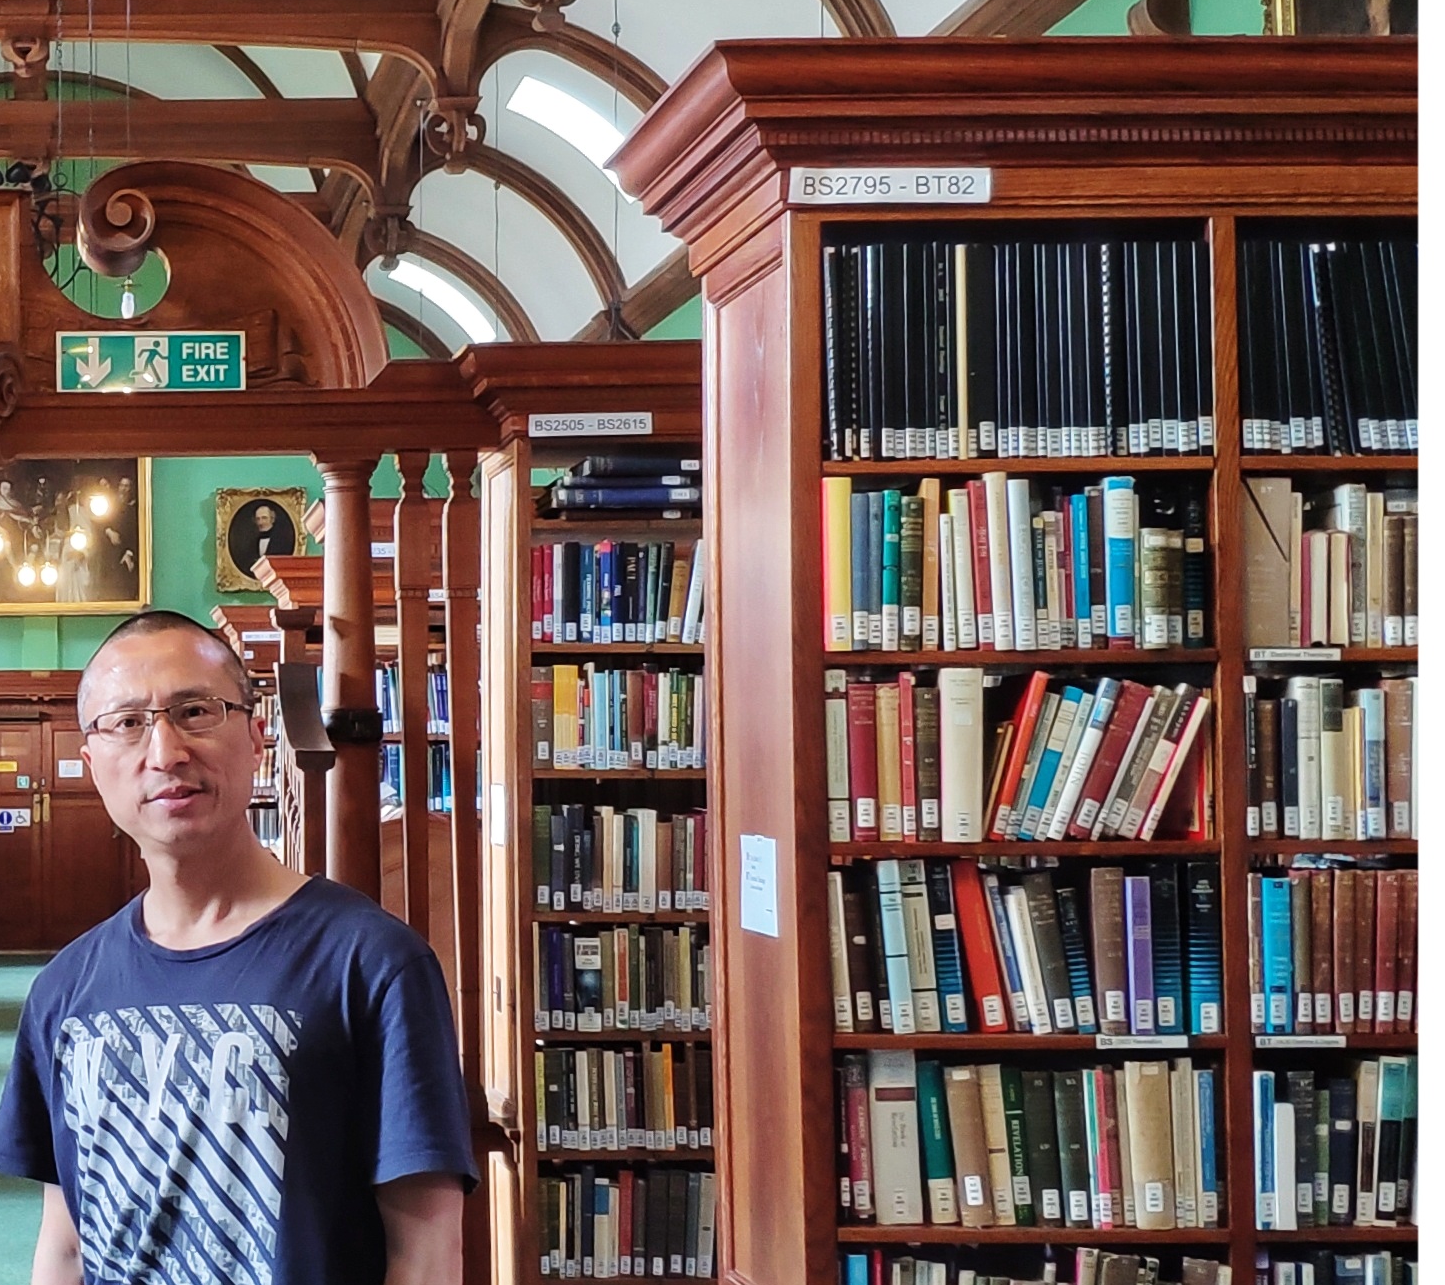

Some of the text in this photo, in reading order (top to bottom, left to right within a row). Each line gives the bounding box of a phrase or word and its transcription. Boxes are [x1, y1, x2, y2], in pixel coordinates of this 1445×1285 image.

[802, 175, 892, 196] BS2795
[915, 175, 976, 196] BT82
[182, 341, 230, 360] FIRE
[181, 363, 229, 382] EXIT
[534, 418, 585, 432] BS2505
[597, 417, 647, 431] BS2615
[1070, 751, 1089, 786] JOHN
[1010, 1119, 1024, 1176] REVELATION
